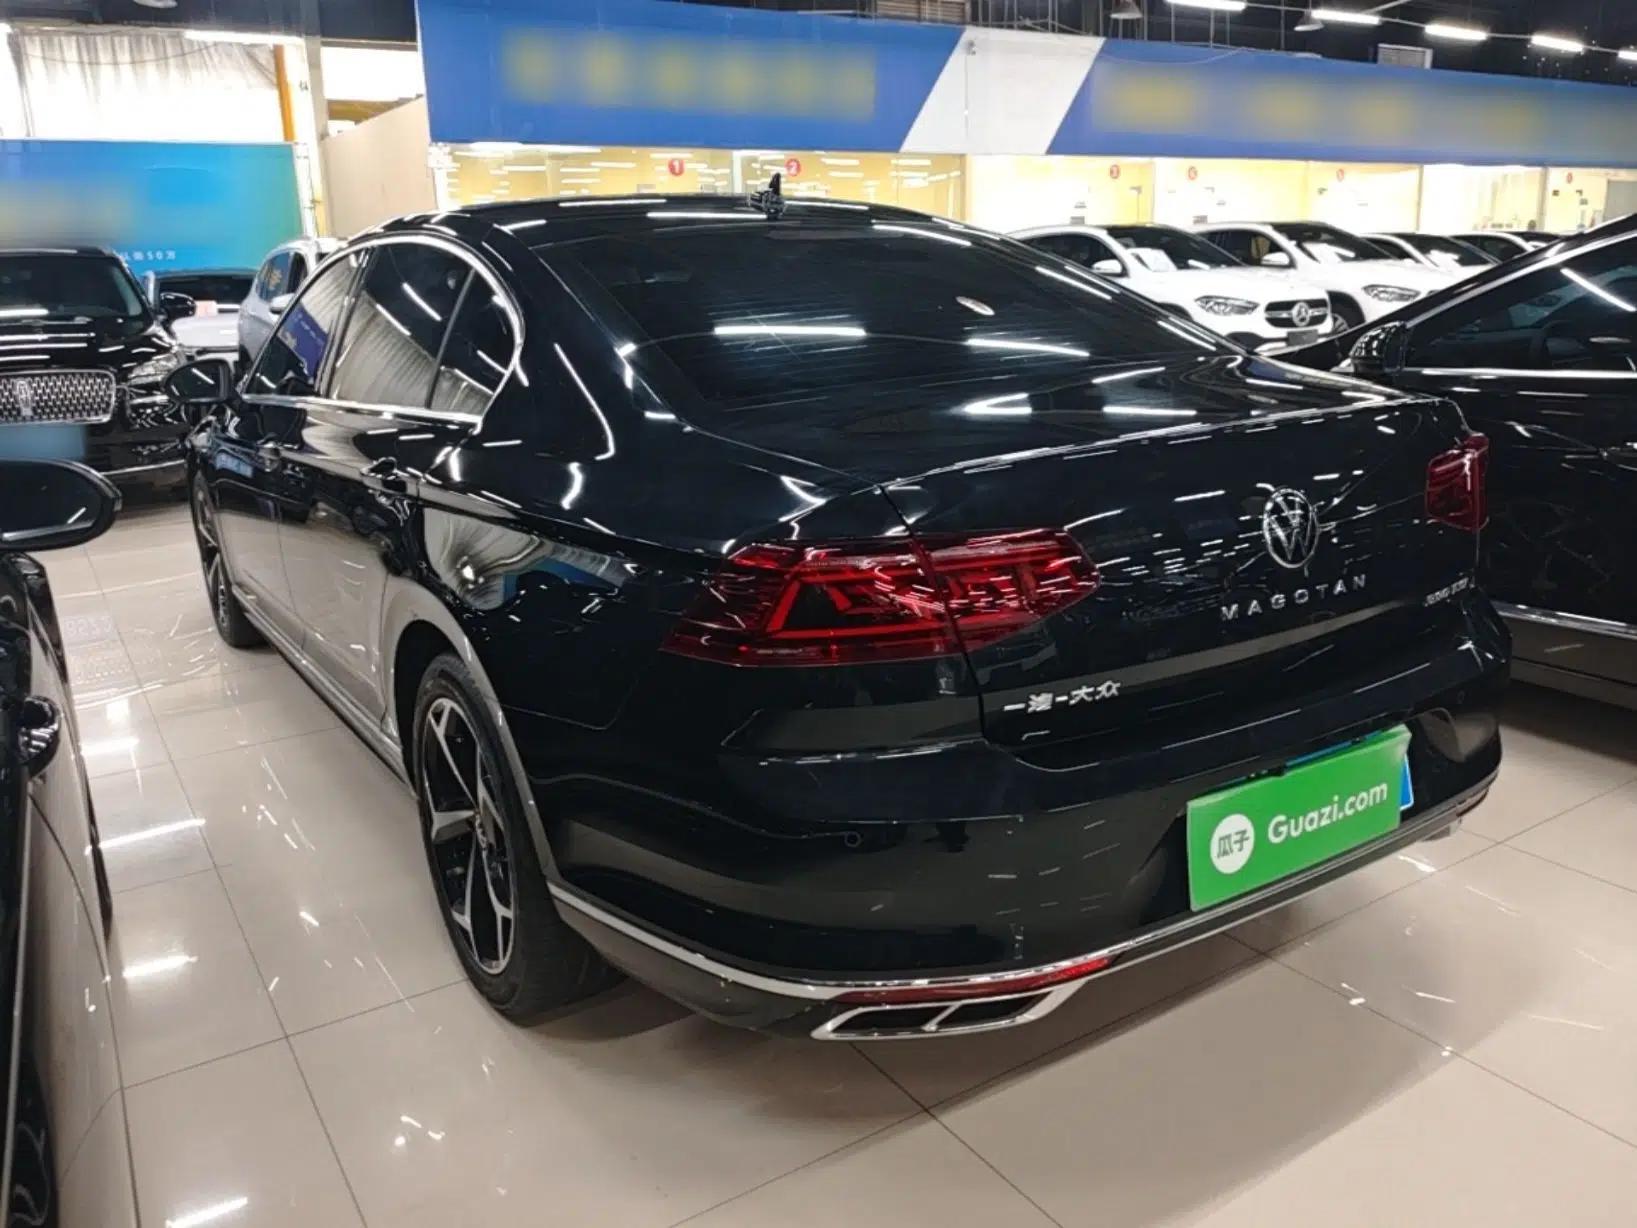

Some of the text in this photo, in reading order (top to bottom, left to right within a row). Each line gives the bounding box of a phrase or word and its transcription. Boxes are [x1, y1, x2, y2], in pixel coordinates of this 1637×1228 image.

[1220, 574, 1367, 621] MAGOTAN
[1267, 783, 1388, 844] Guazi.com
[1216, 829, 1250, 860] 瓜子
